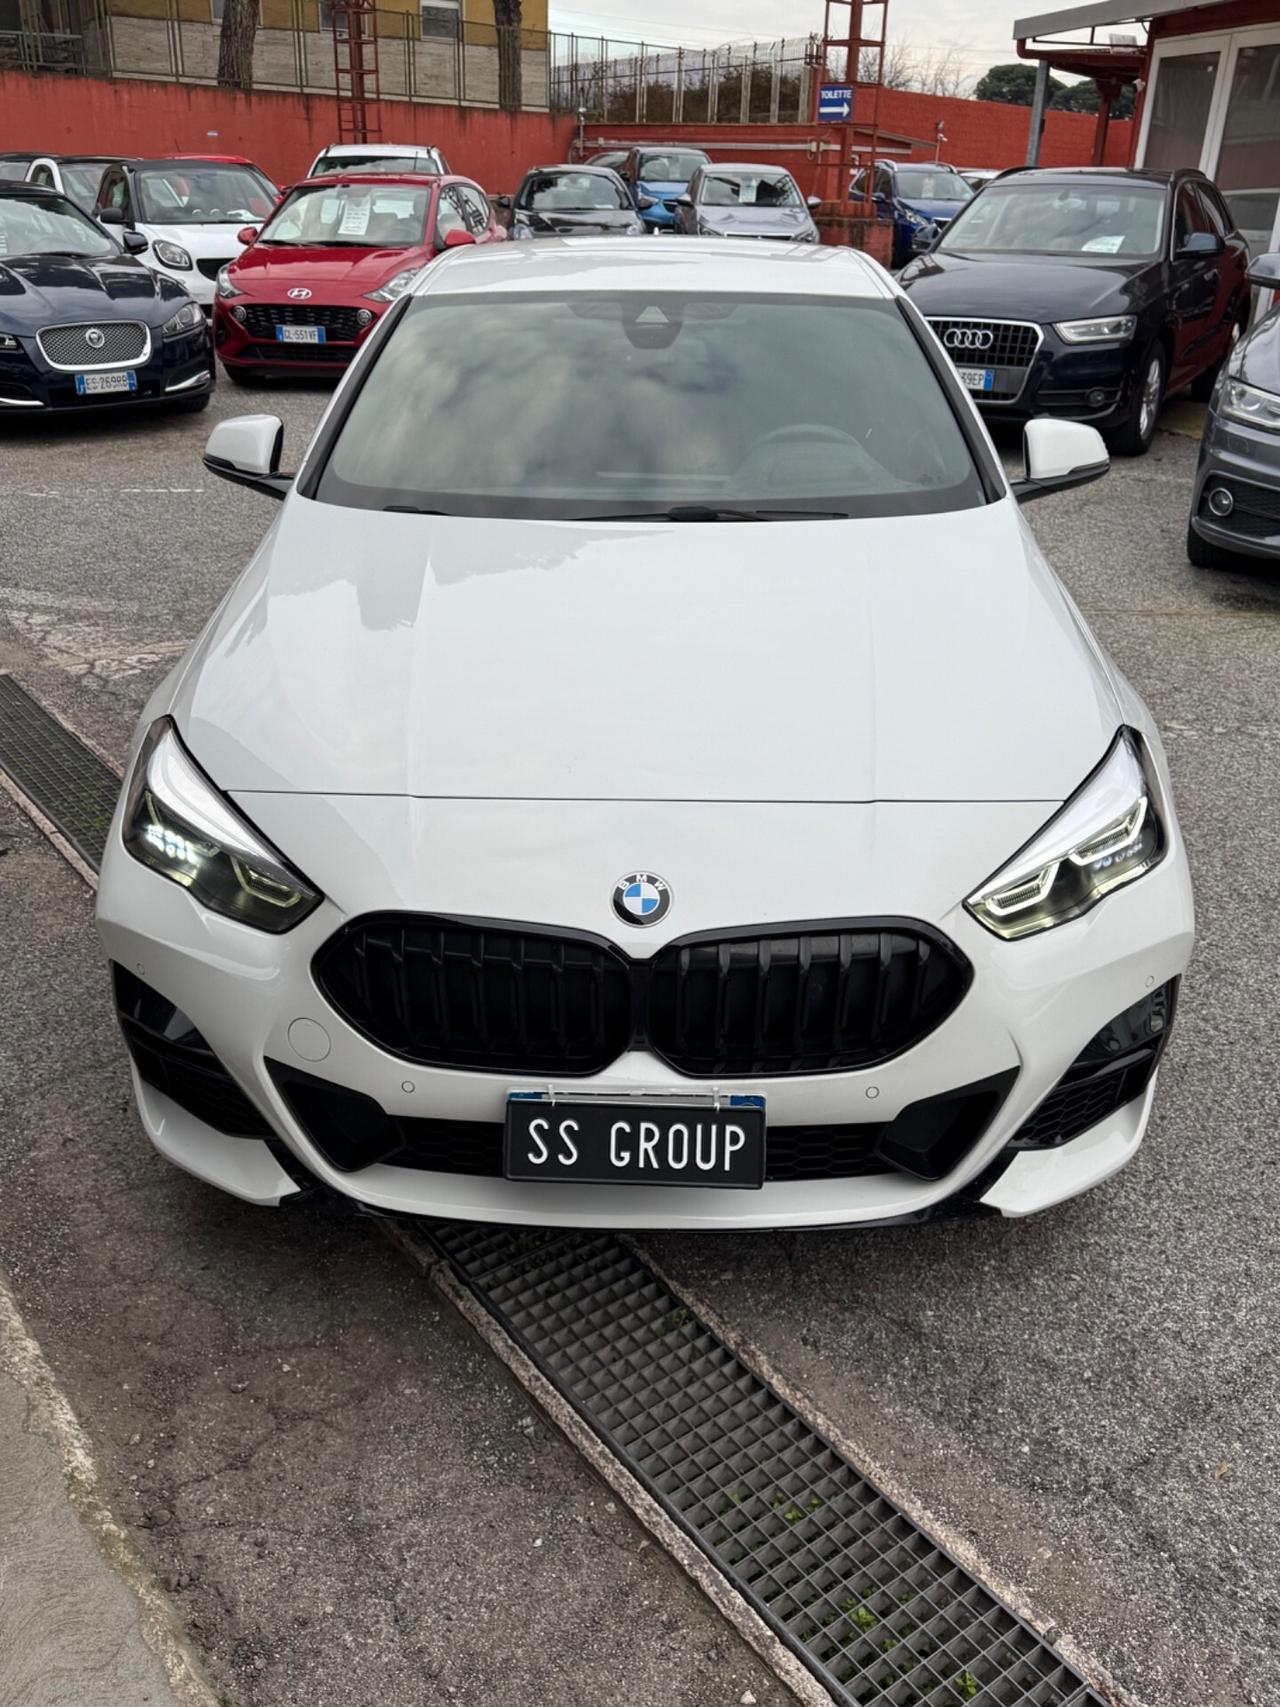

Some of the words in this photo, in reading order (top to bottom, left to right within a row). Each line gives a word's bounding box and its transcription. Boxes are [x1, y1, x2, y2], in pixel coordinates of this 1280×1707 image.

[821, 89, 852, 99] TOILETTE
[617, 873, 668, 891] BMW
[527, 1118, 579, 1166] SS
[609, 1121, 746, 1172] GROUP
